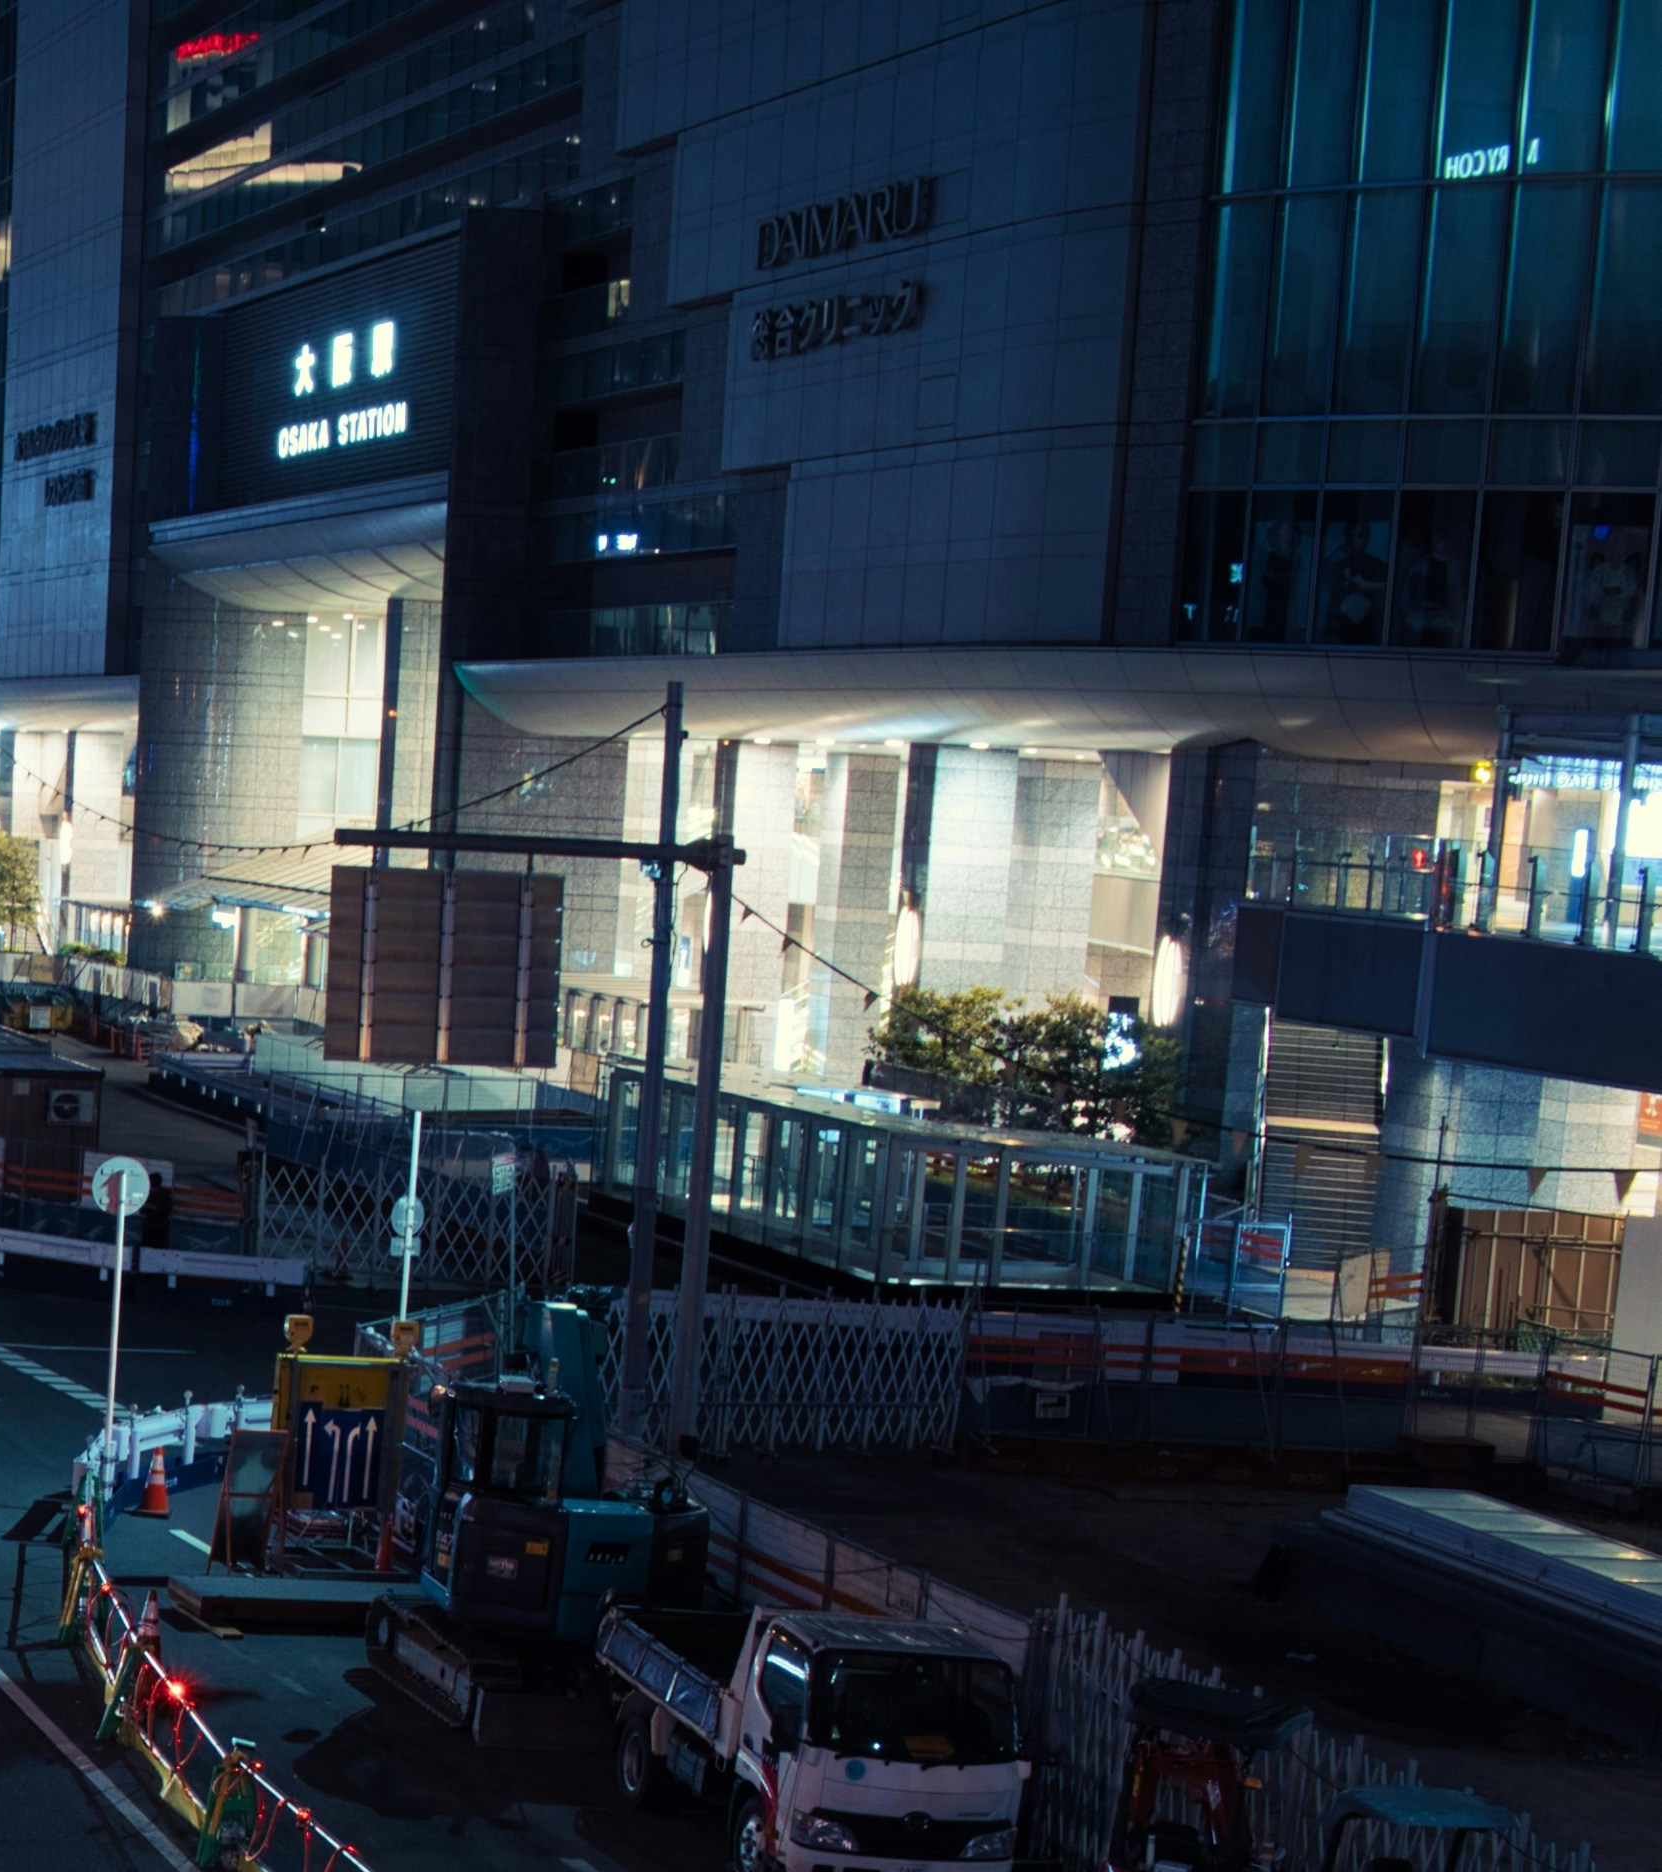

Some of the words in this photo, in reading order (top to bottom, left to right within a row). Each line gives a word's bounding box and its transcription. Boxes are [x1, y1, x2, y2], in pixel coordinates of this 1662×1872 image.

[756, 178, 924, 270] DAIMARU
[751, 281, 922, 362] 総合クリニック
[278, 419, 329, 458] OSAKA
[338, 401, 407, 446] STATION
